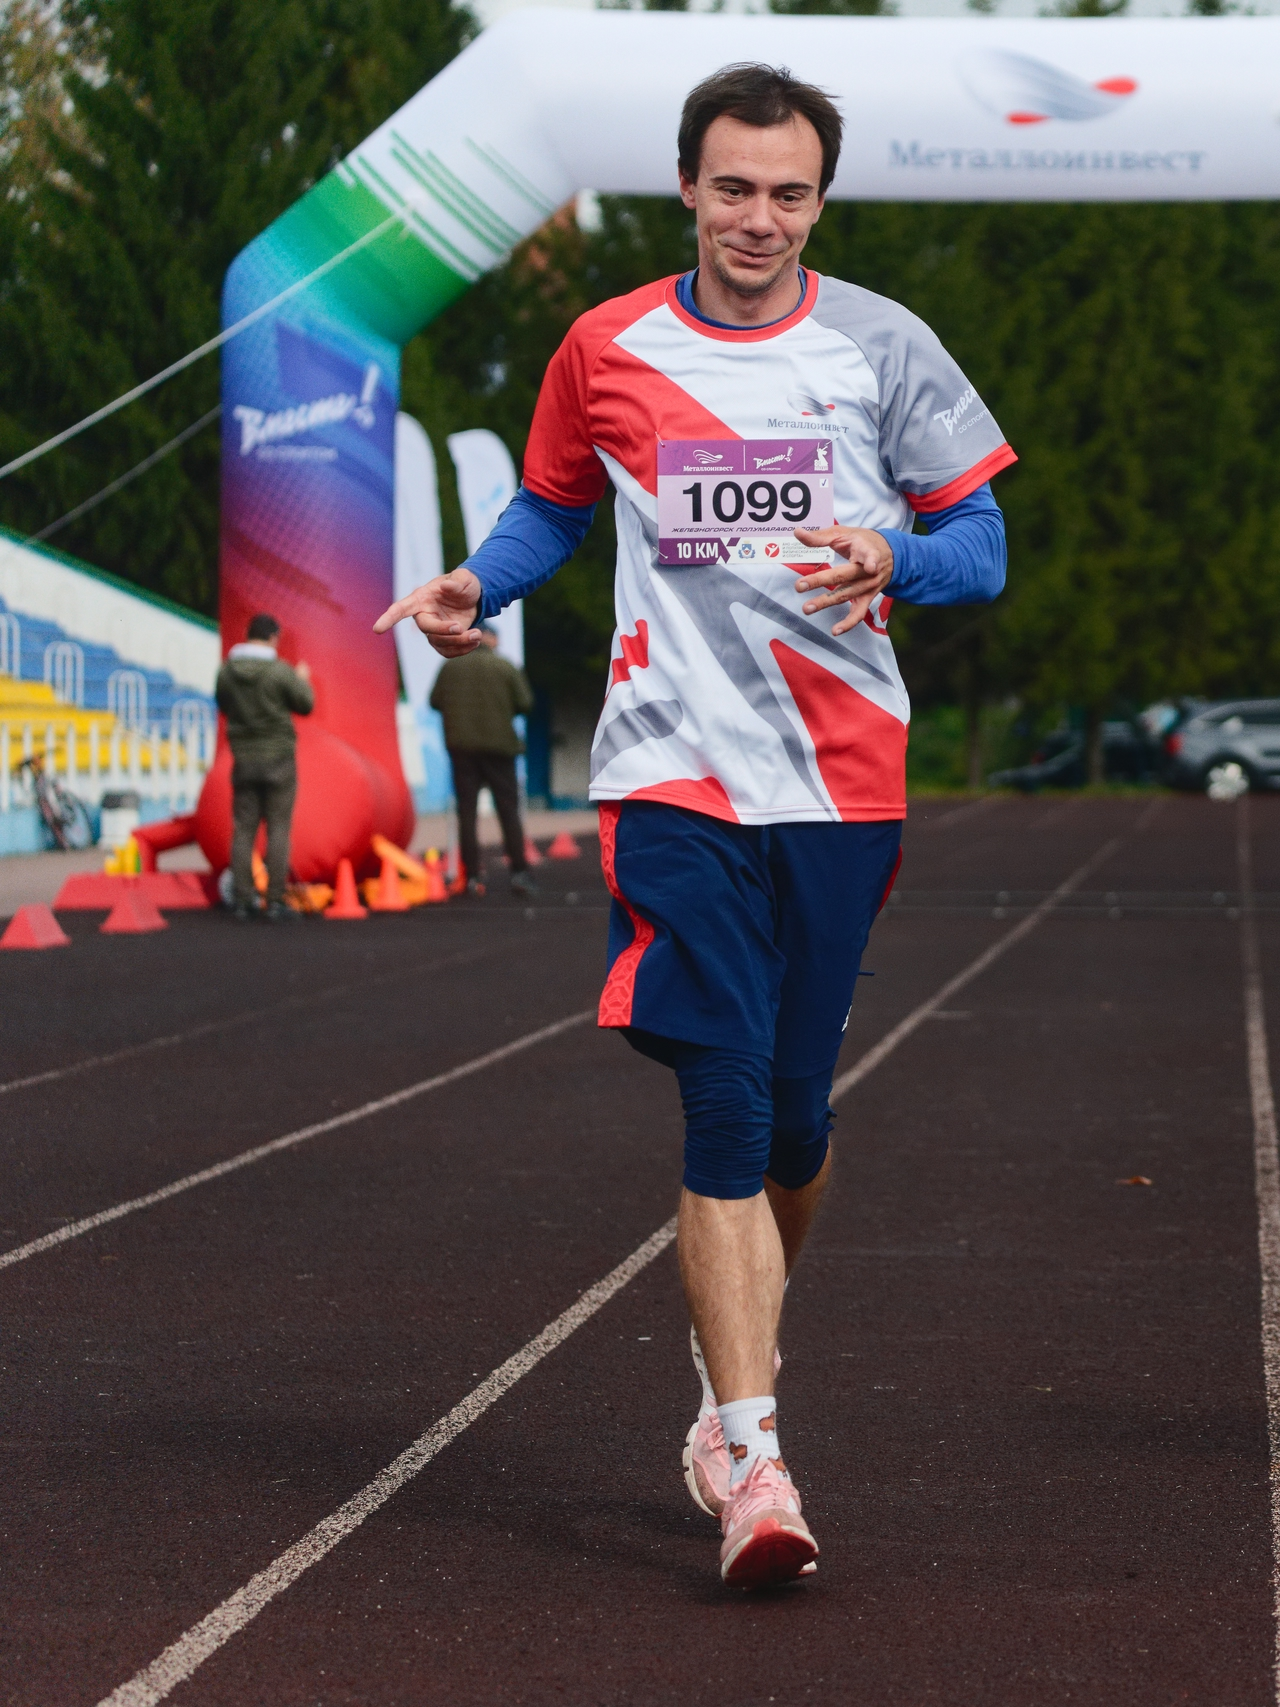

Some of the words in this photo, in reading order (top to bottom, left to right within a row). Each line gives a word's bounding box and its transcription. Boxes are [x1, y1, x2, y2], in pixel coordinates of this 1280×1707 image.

[889, 139, 1206, 172] Металлоинвест
[767, 417, 849, 434] Металлоинвест
[933, 385, 977, 436] Вмес
[682, 480, 812, 523] 1099
[677, 543, 692, 559] 10
[695, 542, 719, 559] КМ
